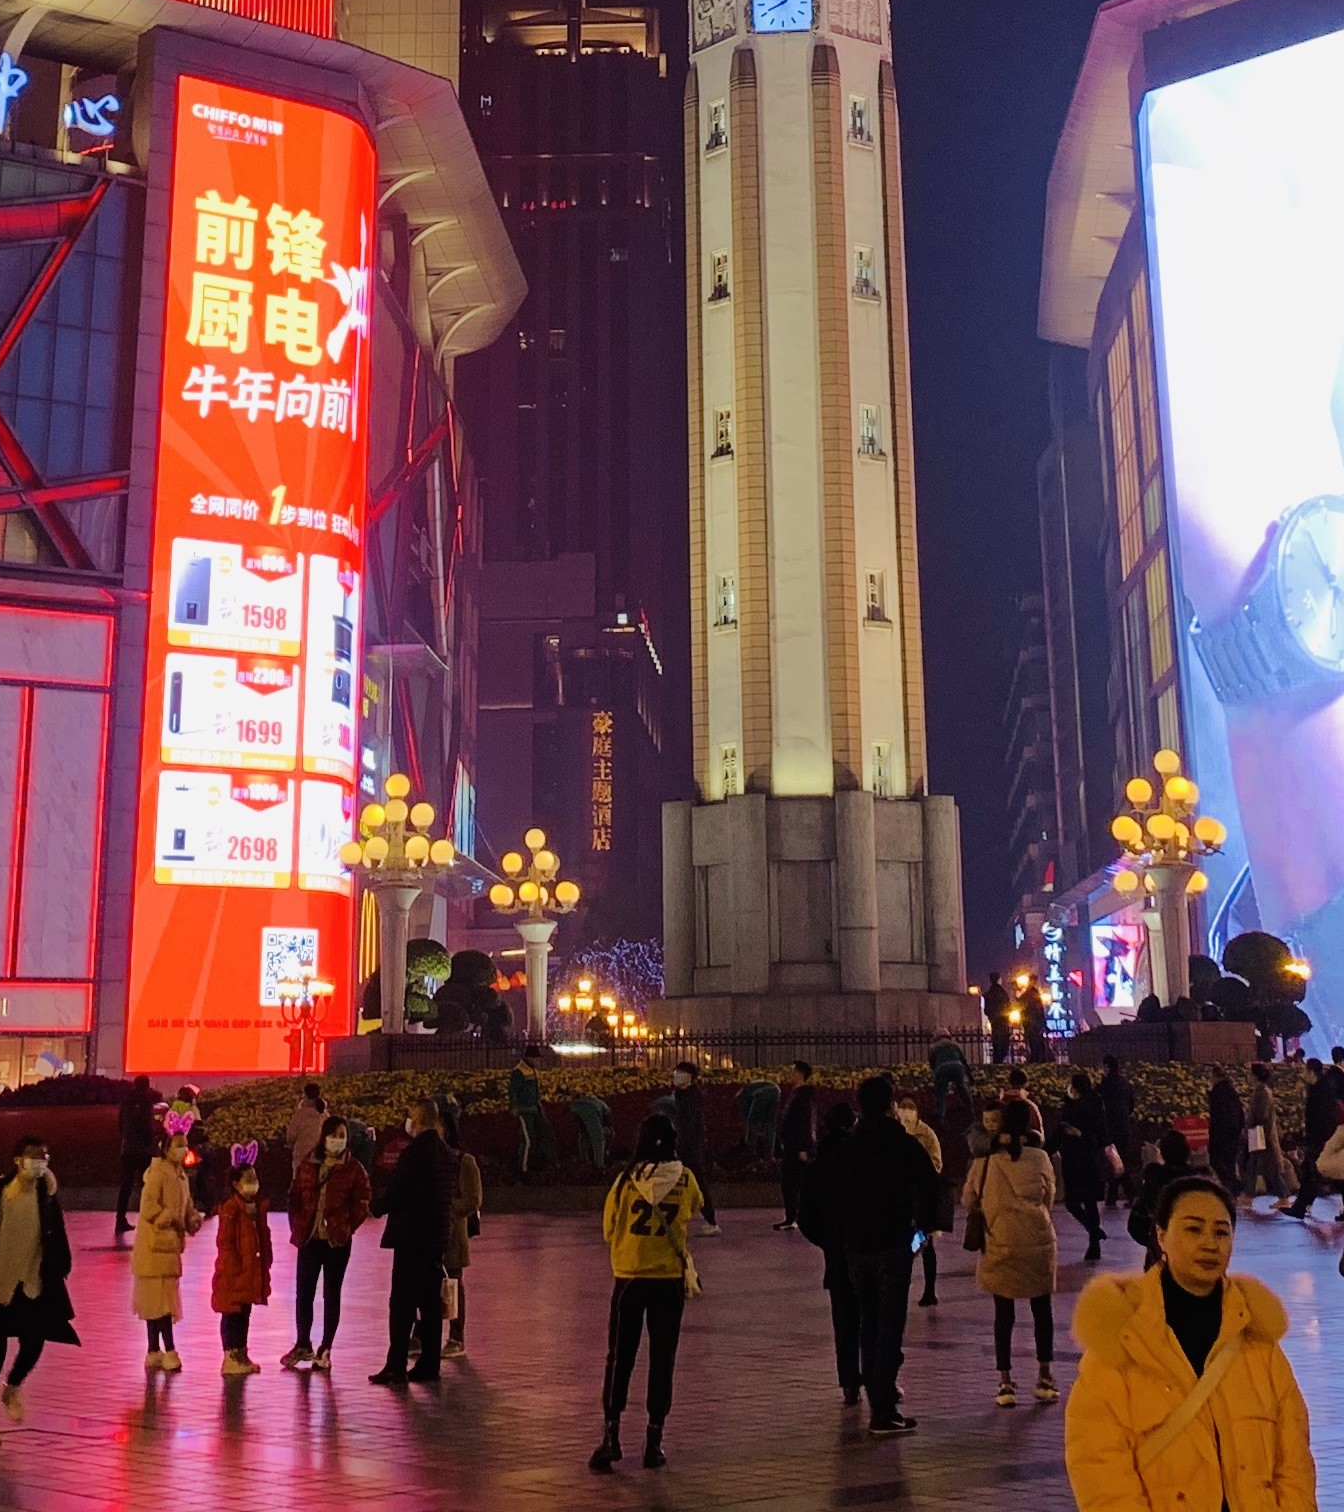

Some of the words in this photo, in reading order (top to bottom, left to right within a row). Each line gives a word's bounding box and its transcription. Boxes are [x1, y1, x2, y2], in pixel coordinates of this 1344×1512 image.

[192, 103, 251, 129] CHIFFO
[195, 190, 327, 284] 前锋
[186, 272, 323, 366] 厨电
[182, 364, 351, 434] 牛年向前
[243, 604, 287, 631] 1598
[236, 720, 283, 746] 1699
[228, 836, 277, 862] 2698
[630, 1199, 680, 1236] 27
